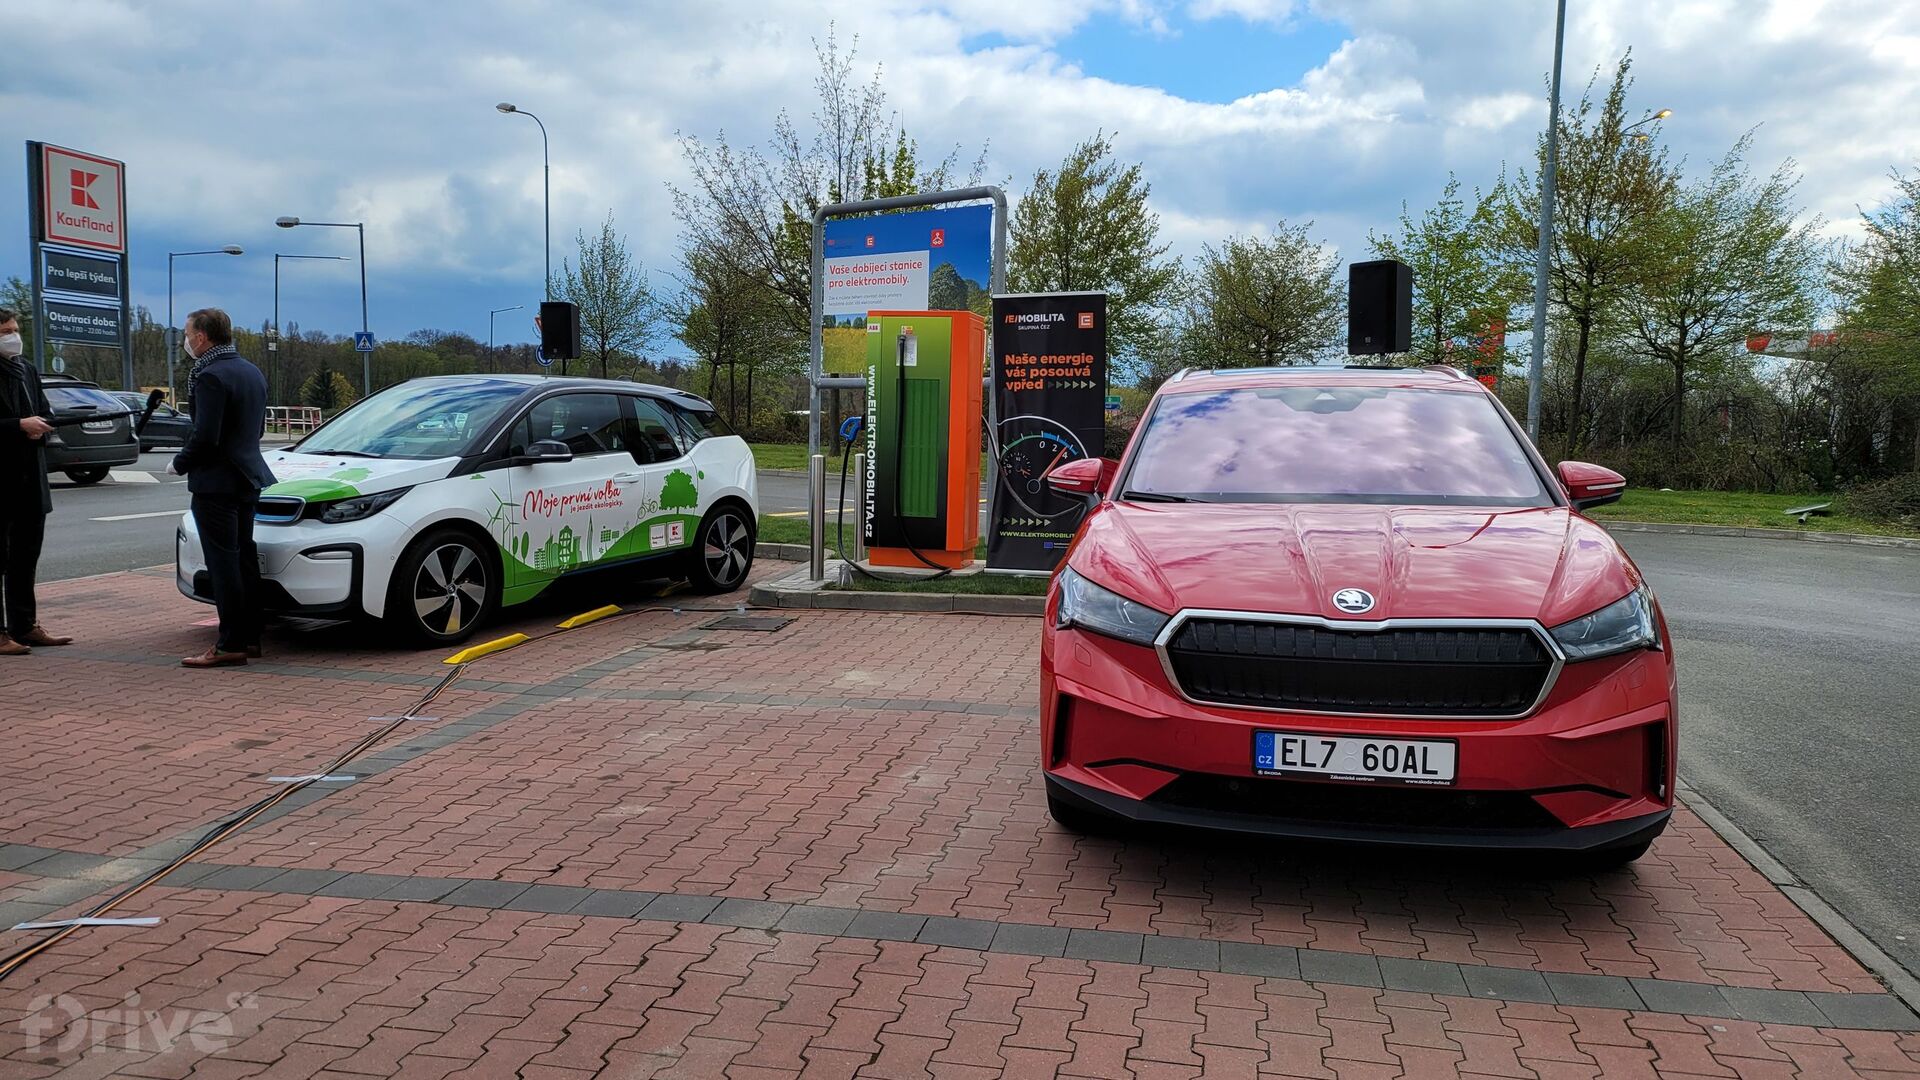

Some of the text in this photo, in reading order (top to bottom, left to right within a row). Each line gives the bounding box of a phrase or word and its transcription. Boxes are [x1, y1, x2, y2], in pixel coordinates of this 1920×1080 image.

[56, 211, 114, 234] Kaufland
[48, 265, 116, 284] Pro lepší týden.
[829, 264, 850, 275] Vaše
[889, 260, 923, 271] stanice
[829, 274, 910, 290] pro elektromobily.
[1005, 352, 1094, 366] Naše energie
[1005, 365, 1091, 379] vás posouvá
[1005, 379, 1044, 392] vpřed
[865, 365, 877, 538] www.ELEKTROMOBILITA.cz
[523, 479, 621, 520] Moje první volba
[570, 505, 577, 513] je
[577, 503, 594, 512] jezdit
[1258, 755, 1272, 765] CZ
[1281, 737, 1439, 775] EL7 60AL
